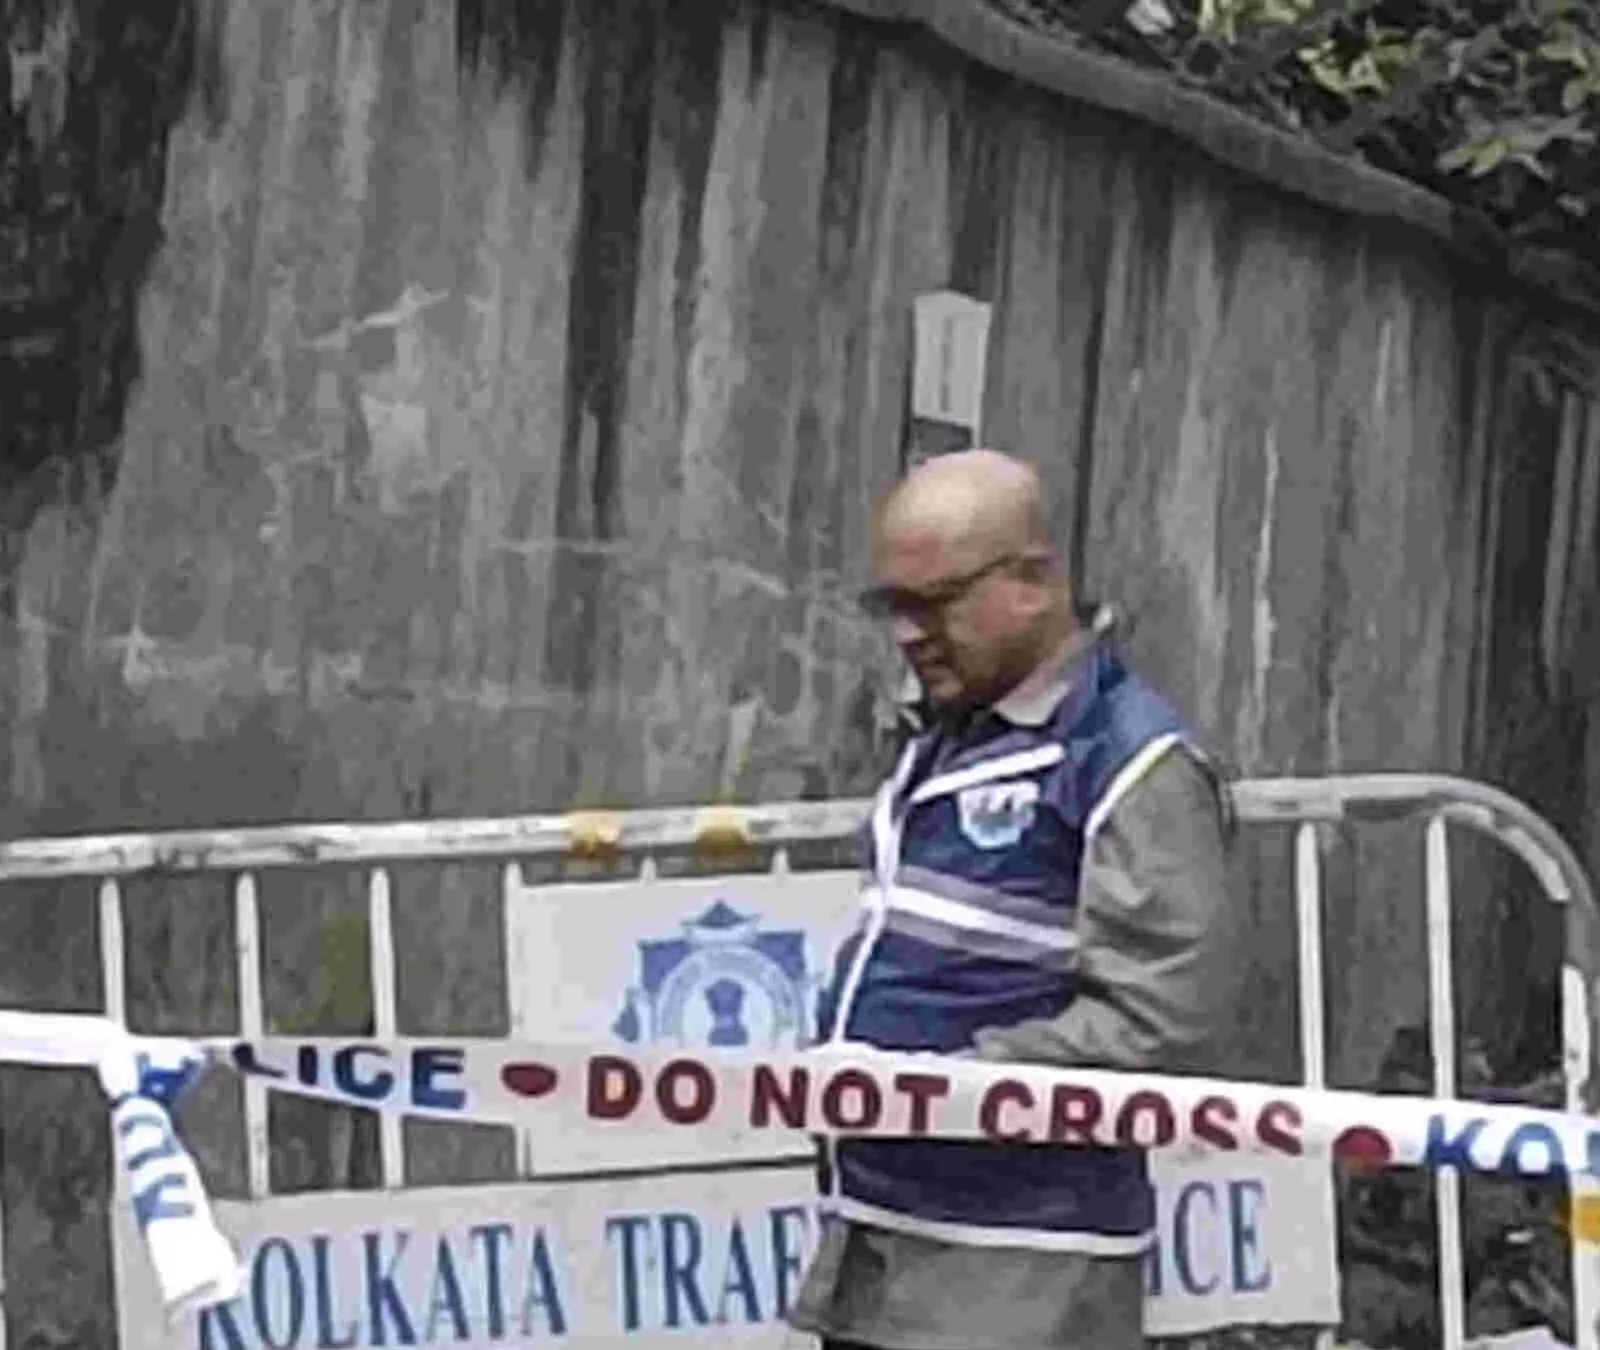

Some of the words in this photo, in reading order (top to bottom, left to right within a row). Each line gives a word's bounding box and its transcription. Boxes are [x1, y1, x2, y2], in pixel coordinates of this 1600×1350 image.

[232, 1043, 467, 1110] LICE
[587, 1055, 716, 1125] DO
[750, 1064, 950, 1135] NOT
[979, 1079, 1304, 1157] CROSS
[605, 1206, 804, 1332] TRAF
